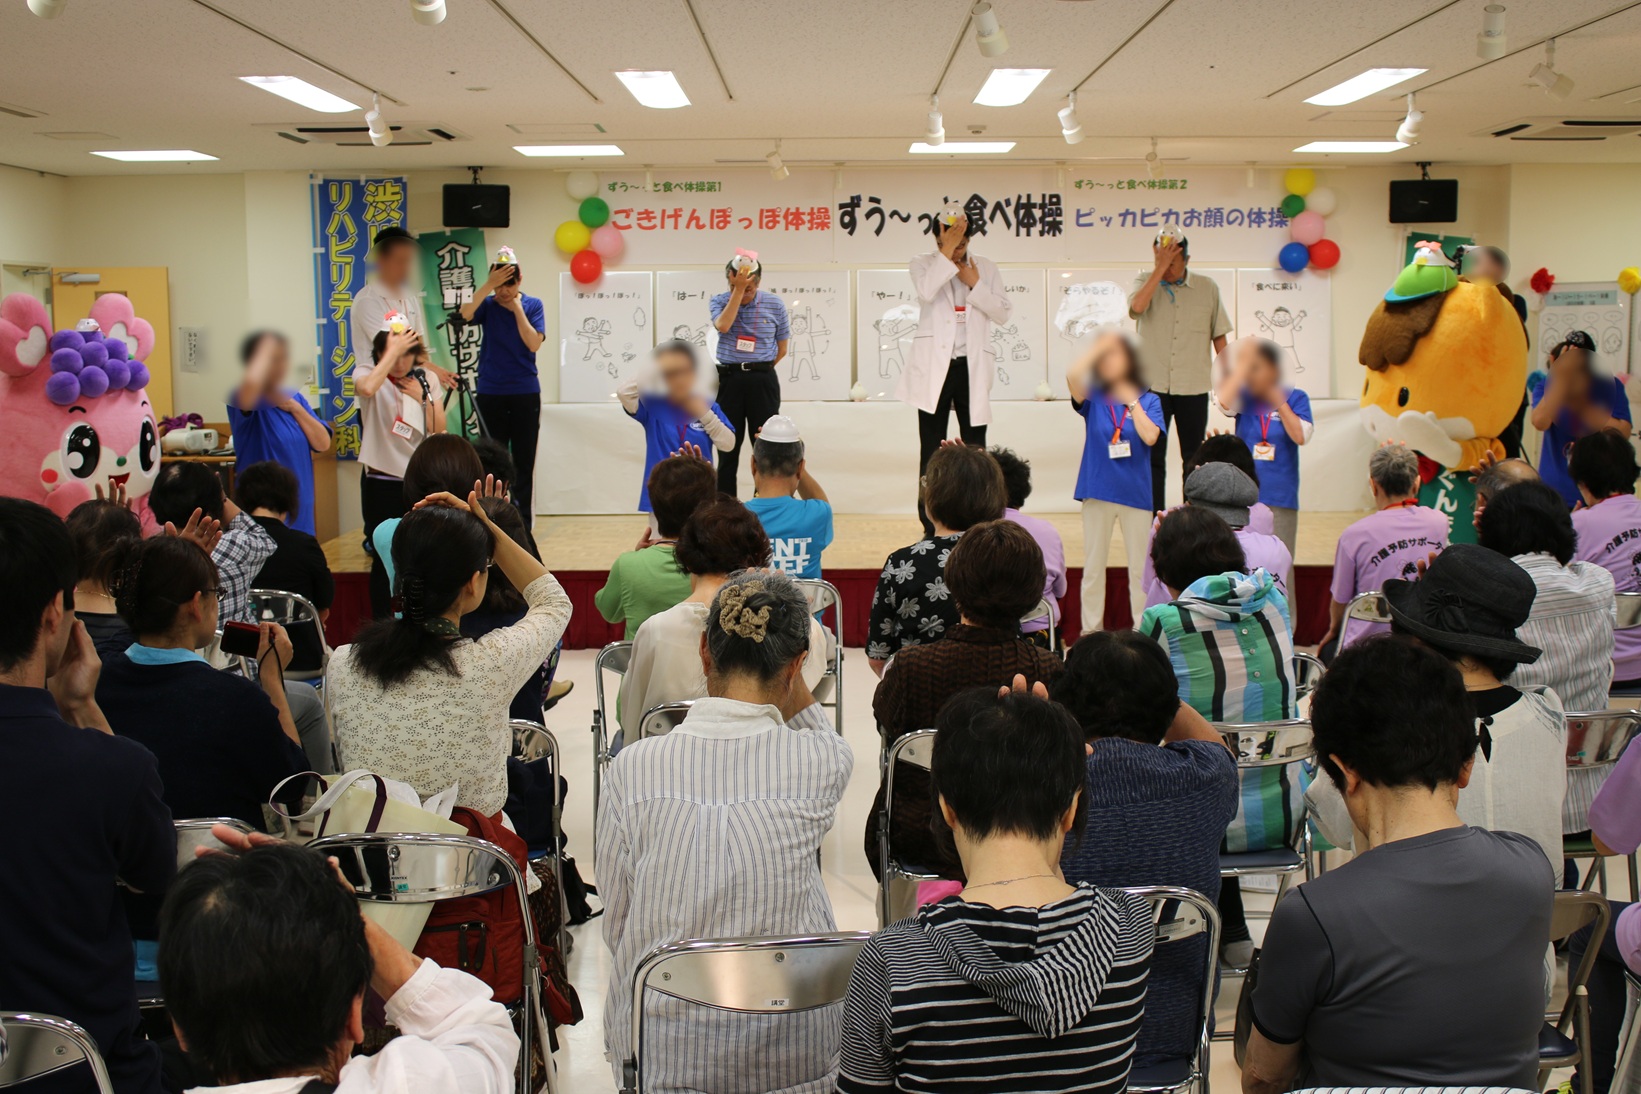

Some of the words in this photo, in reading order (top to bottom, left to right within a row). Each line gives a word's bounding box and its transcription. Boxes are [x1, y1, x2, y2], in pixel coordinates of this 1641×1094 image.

[608, 181, 721, 192] ずう～と食べ体操第1
[611, 207, 831, 231] ごきげんぽっぽ体操
[838, 193, 1064, 237] ずう～っ食べ体操
[1075, 207, 1289, 228] ピッカピカお顔の体操
[326, 181, 361, 456] リハビリテーション科
[1370, 537, 1445, 567] 介護予防サポータ
